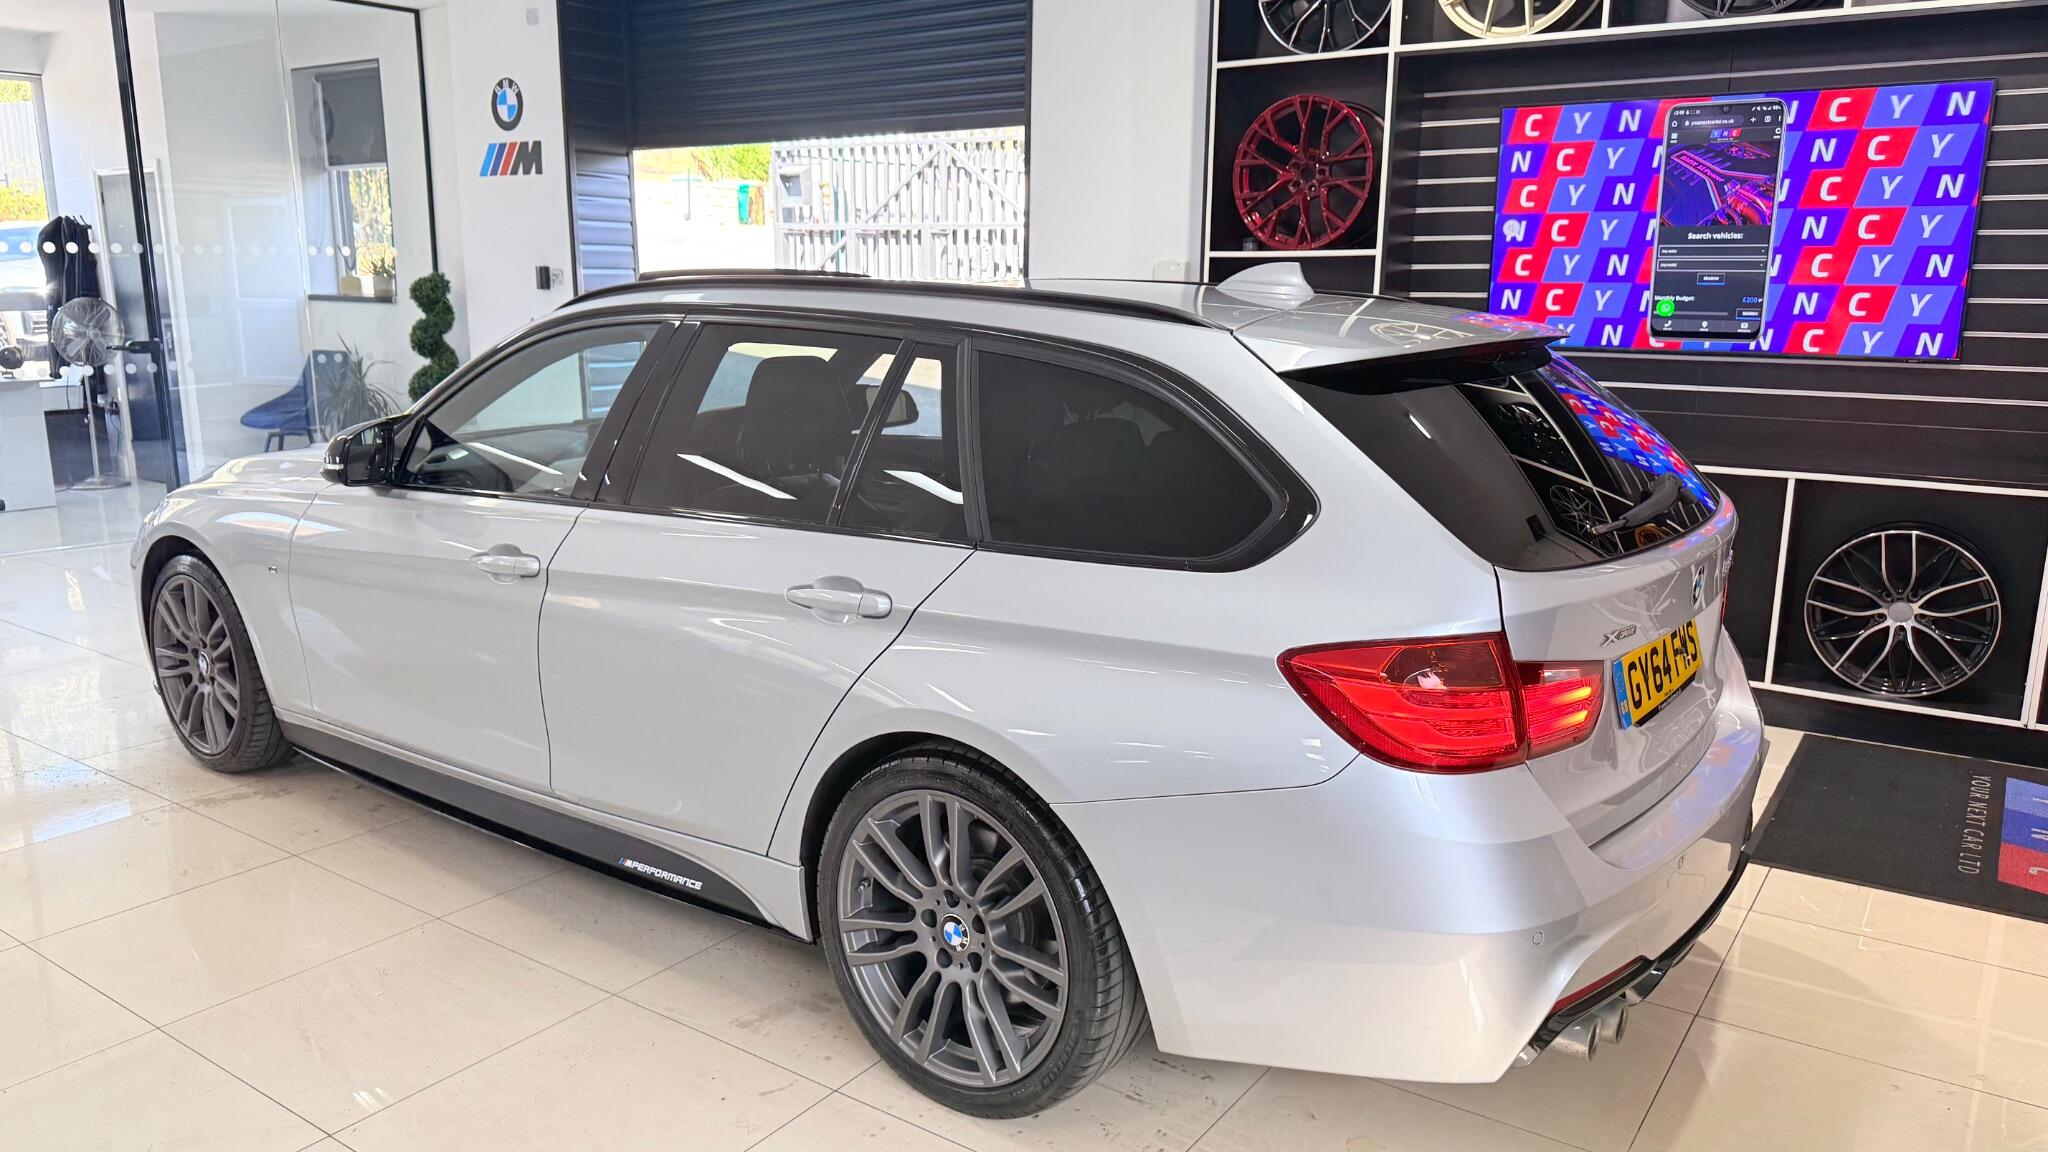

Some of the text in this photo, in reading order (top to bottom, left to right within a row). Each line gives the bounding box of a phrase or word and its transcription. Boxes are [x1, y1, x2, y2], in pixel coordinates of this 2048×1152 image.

[494, 79, 520, 95] BMW
[1524, 113, 1543, 137] C
[1573, 111, 1592, 135] Y
[1618, 109, 1642, 132] N
[1828, 97, 1851, 123] C
[1890, 94, 1914, 119] Y
[1946, 90, 1976, 117] N
[508, 140, 543, 176] M
[1510, 150, 1532, 173] N
[1556, 148, 1575, 172] C
[1606, 146, 1626, 170] Y
[1810, 138, 1837, 163] N
[1867, 135, 1890, 161] C
[1931, 133, 1955, 159] Y
[1519, 184, 1538, 208] C
[1568, 183, 1587, 206] Y
[1612, 182, 1636, 205] N
[1819, 176, 1842, 202] C
[1881, 175, 1904, 200] Y
[1936, 173, 1965, 199] N
[1551, 219, 1569, 242] C
[1600, 218, 1619, 241] Y
[1801, 216, 1828, 240] N
[1857, 214, 1880, 240] C
[1920, 214, 1944, 239] Y
[1687, 232, 1743, 240] Search vehicles:
[1515, 253, 1954, 278] C Y N C Y N
[1500, 289, 1522, 310] N
[1545, 288, 1564, 311] C
[1594, 289, 1614, 312] Y
[1792, 292, 1819, 315] N
[1848, 292, 1871, 317] C
[1910, 293, 1934, 318] Y
[1600, 324, 1623, 346] N
[1802, 328, 1824, 353] C
[1862, 330, 1885, 354] Y
[1915, 332, 1944, 356] N
[1628, 639, 1673, 710] GY64
[1958, 775, 1992, 875] YOUR NEXT CAR LTD
